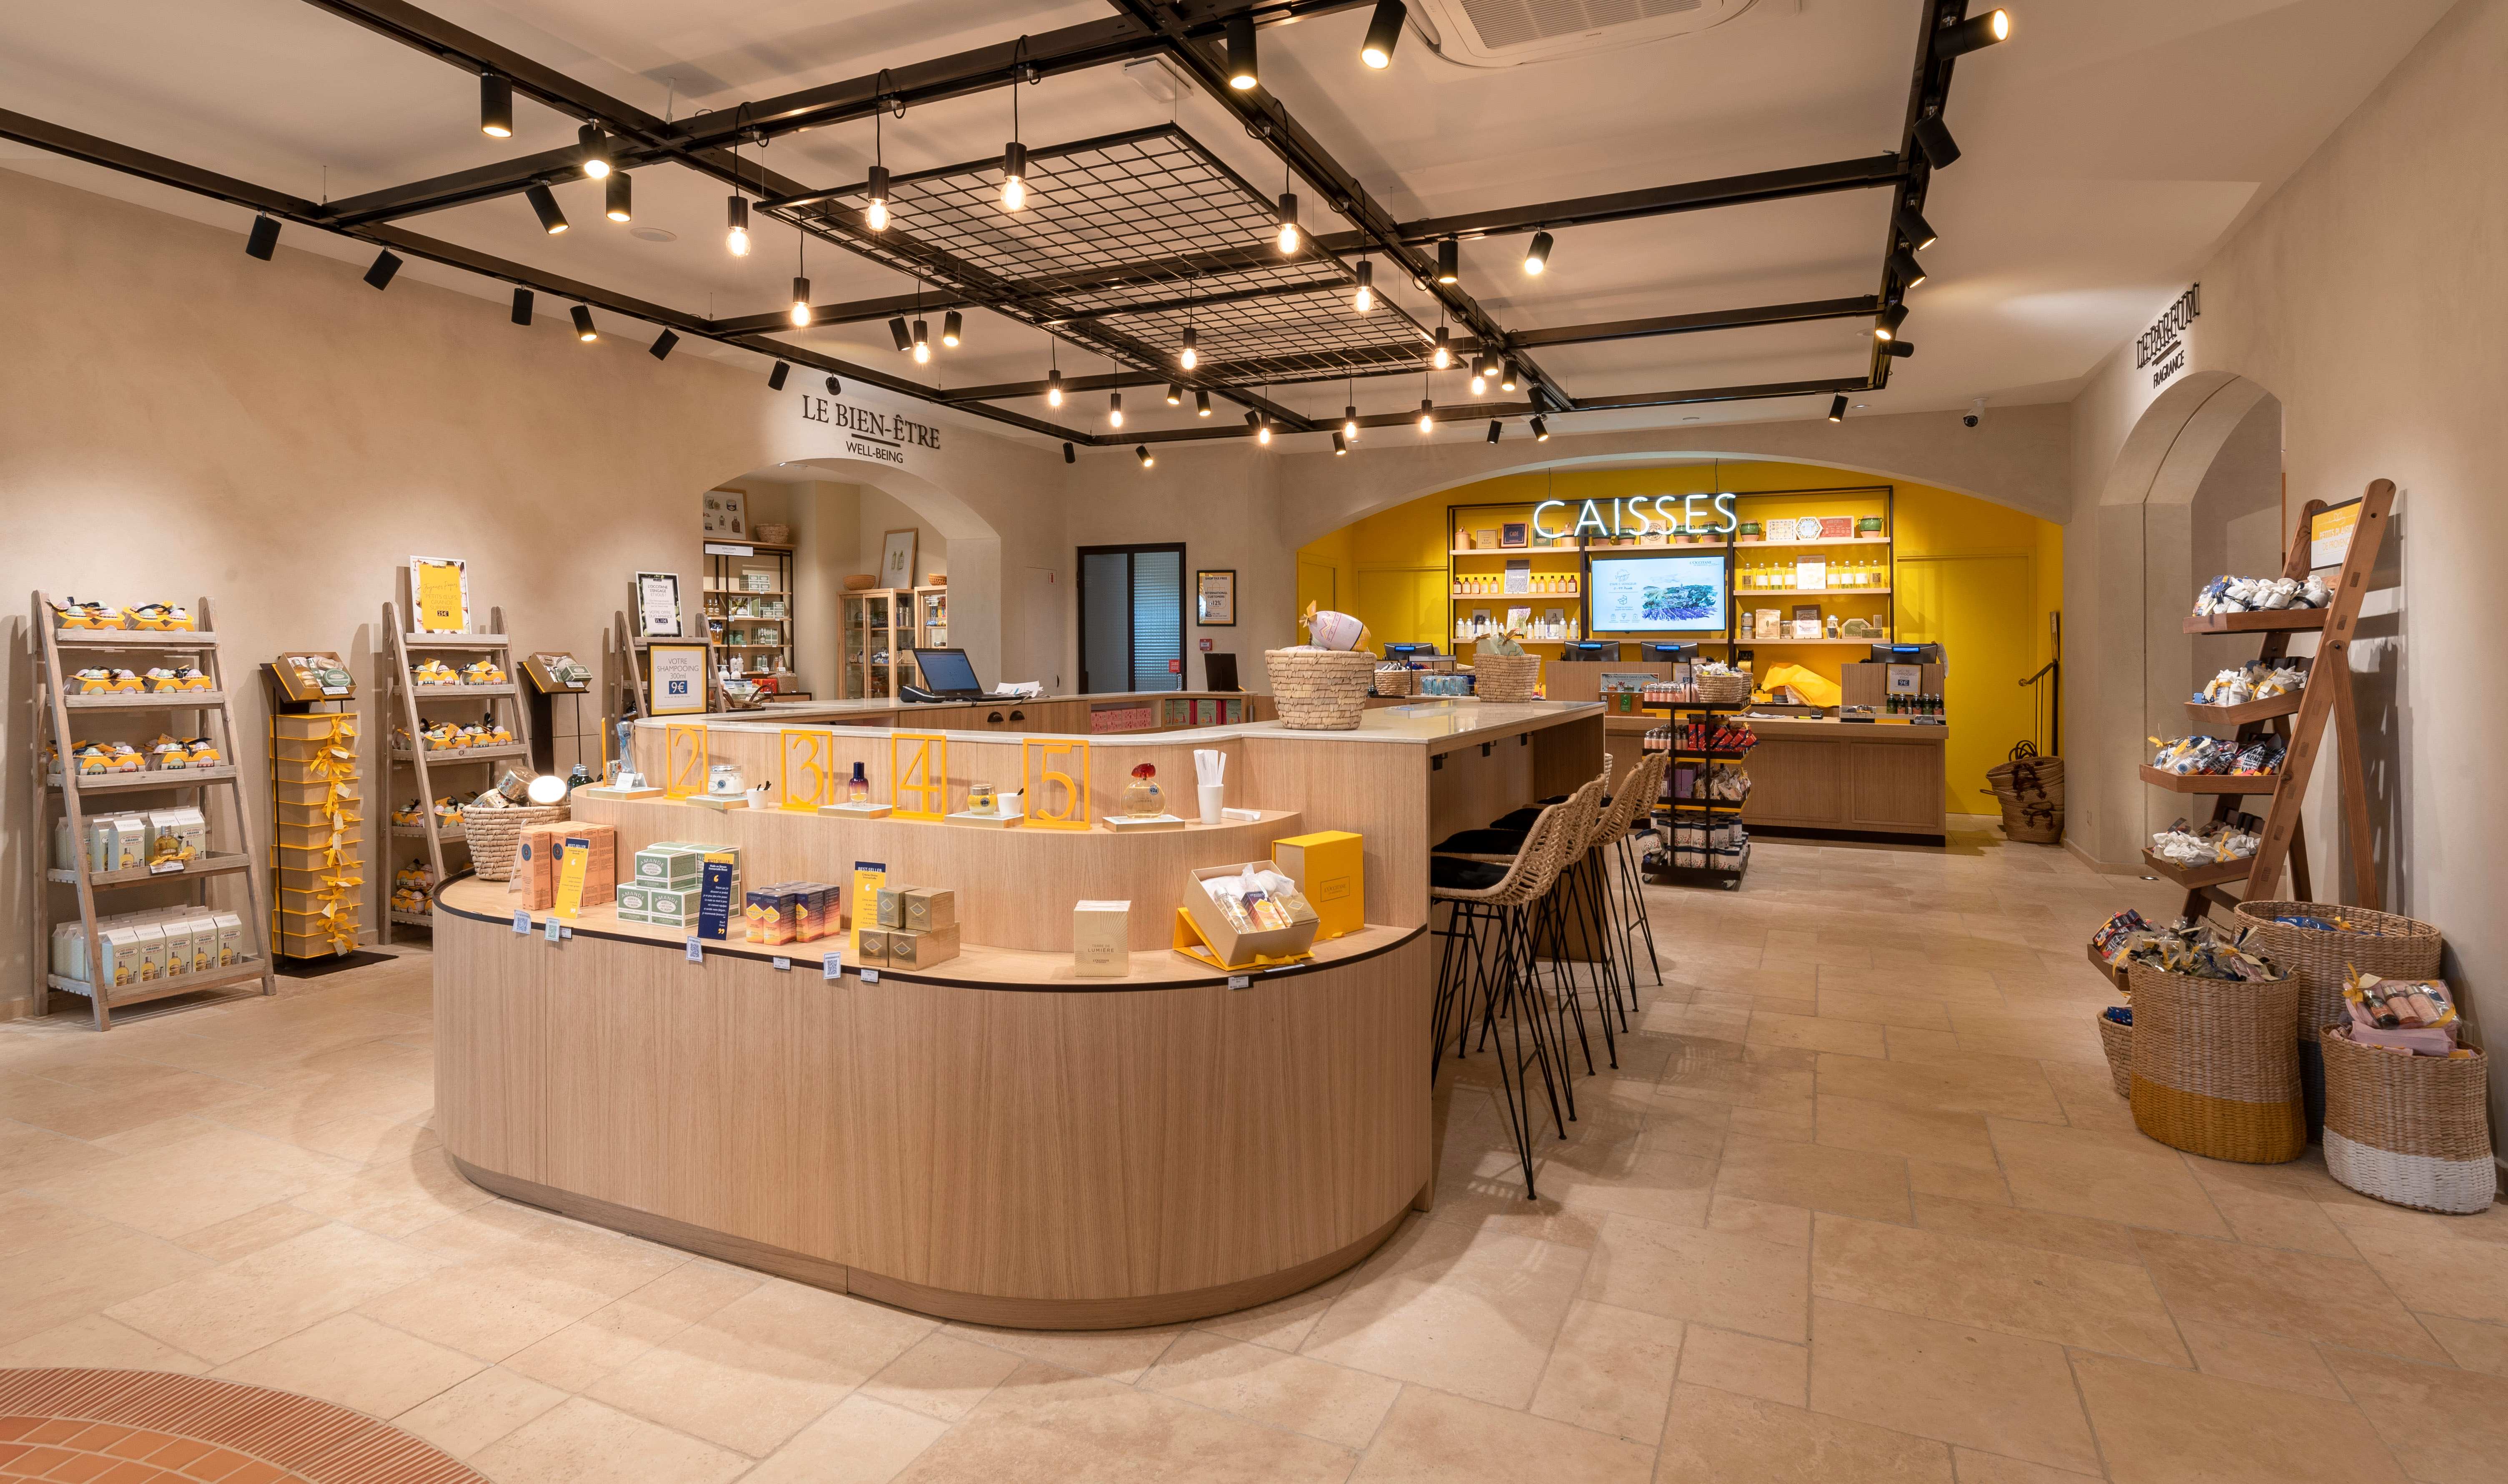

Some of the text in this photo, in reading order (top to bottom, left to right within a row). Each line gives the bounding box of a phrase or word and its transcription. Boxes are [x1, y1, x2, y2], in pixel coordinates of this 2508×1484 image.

[2154, 349, 2184, 389] FRAGRANCE
[803, 395, 940, 449] LE BIEN-ÊTRE
[846, 441, 903, 463] WELL-BEING
[1533, 493, 1737, 539] CAISSES
[671, 682, 685, 693] 9€
[674, 728, 702, 793] 2
[792, 733, 825, 805] 3
[899, 739, 939, 815] 4
[1037, 744, 1077, 821] 5
[640, 858, 664, 867] AMANDE
[622, 891, 644, 900] AMANDE
[655, 895, 678, 905] AMANDE
